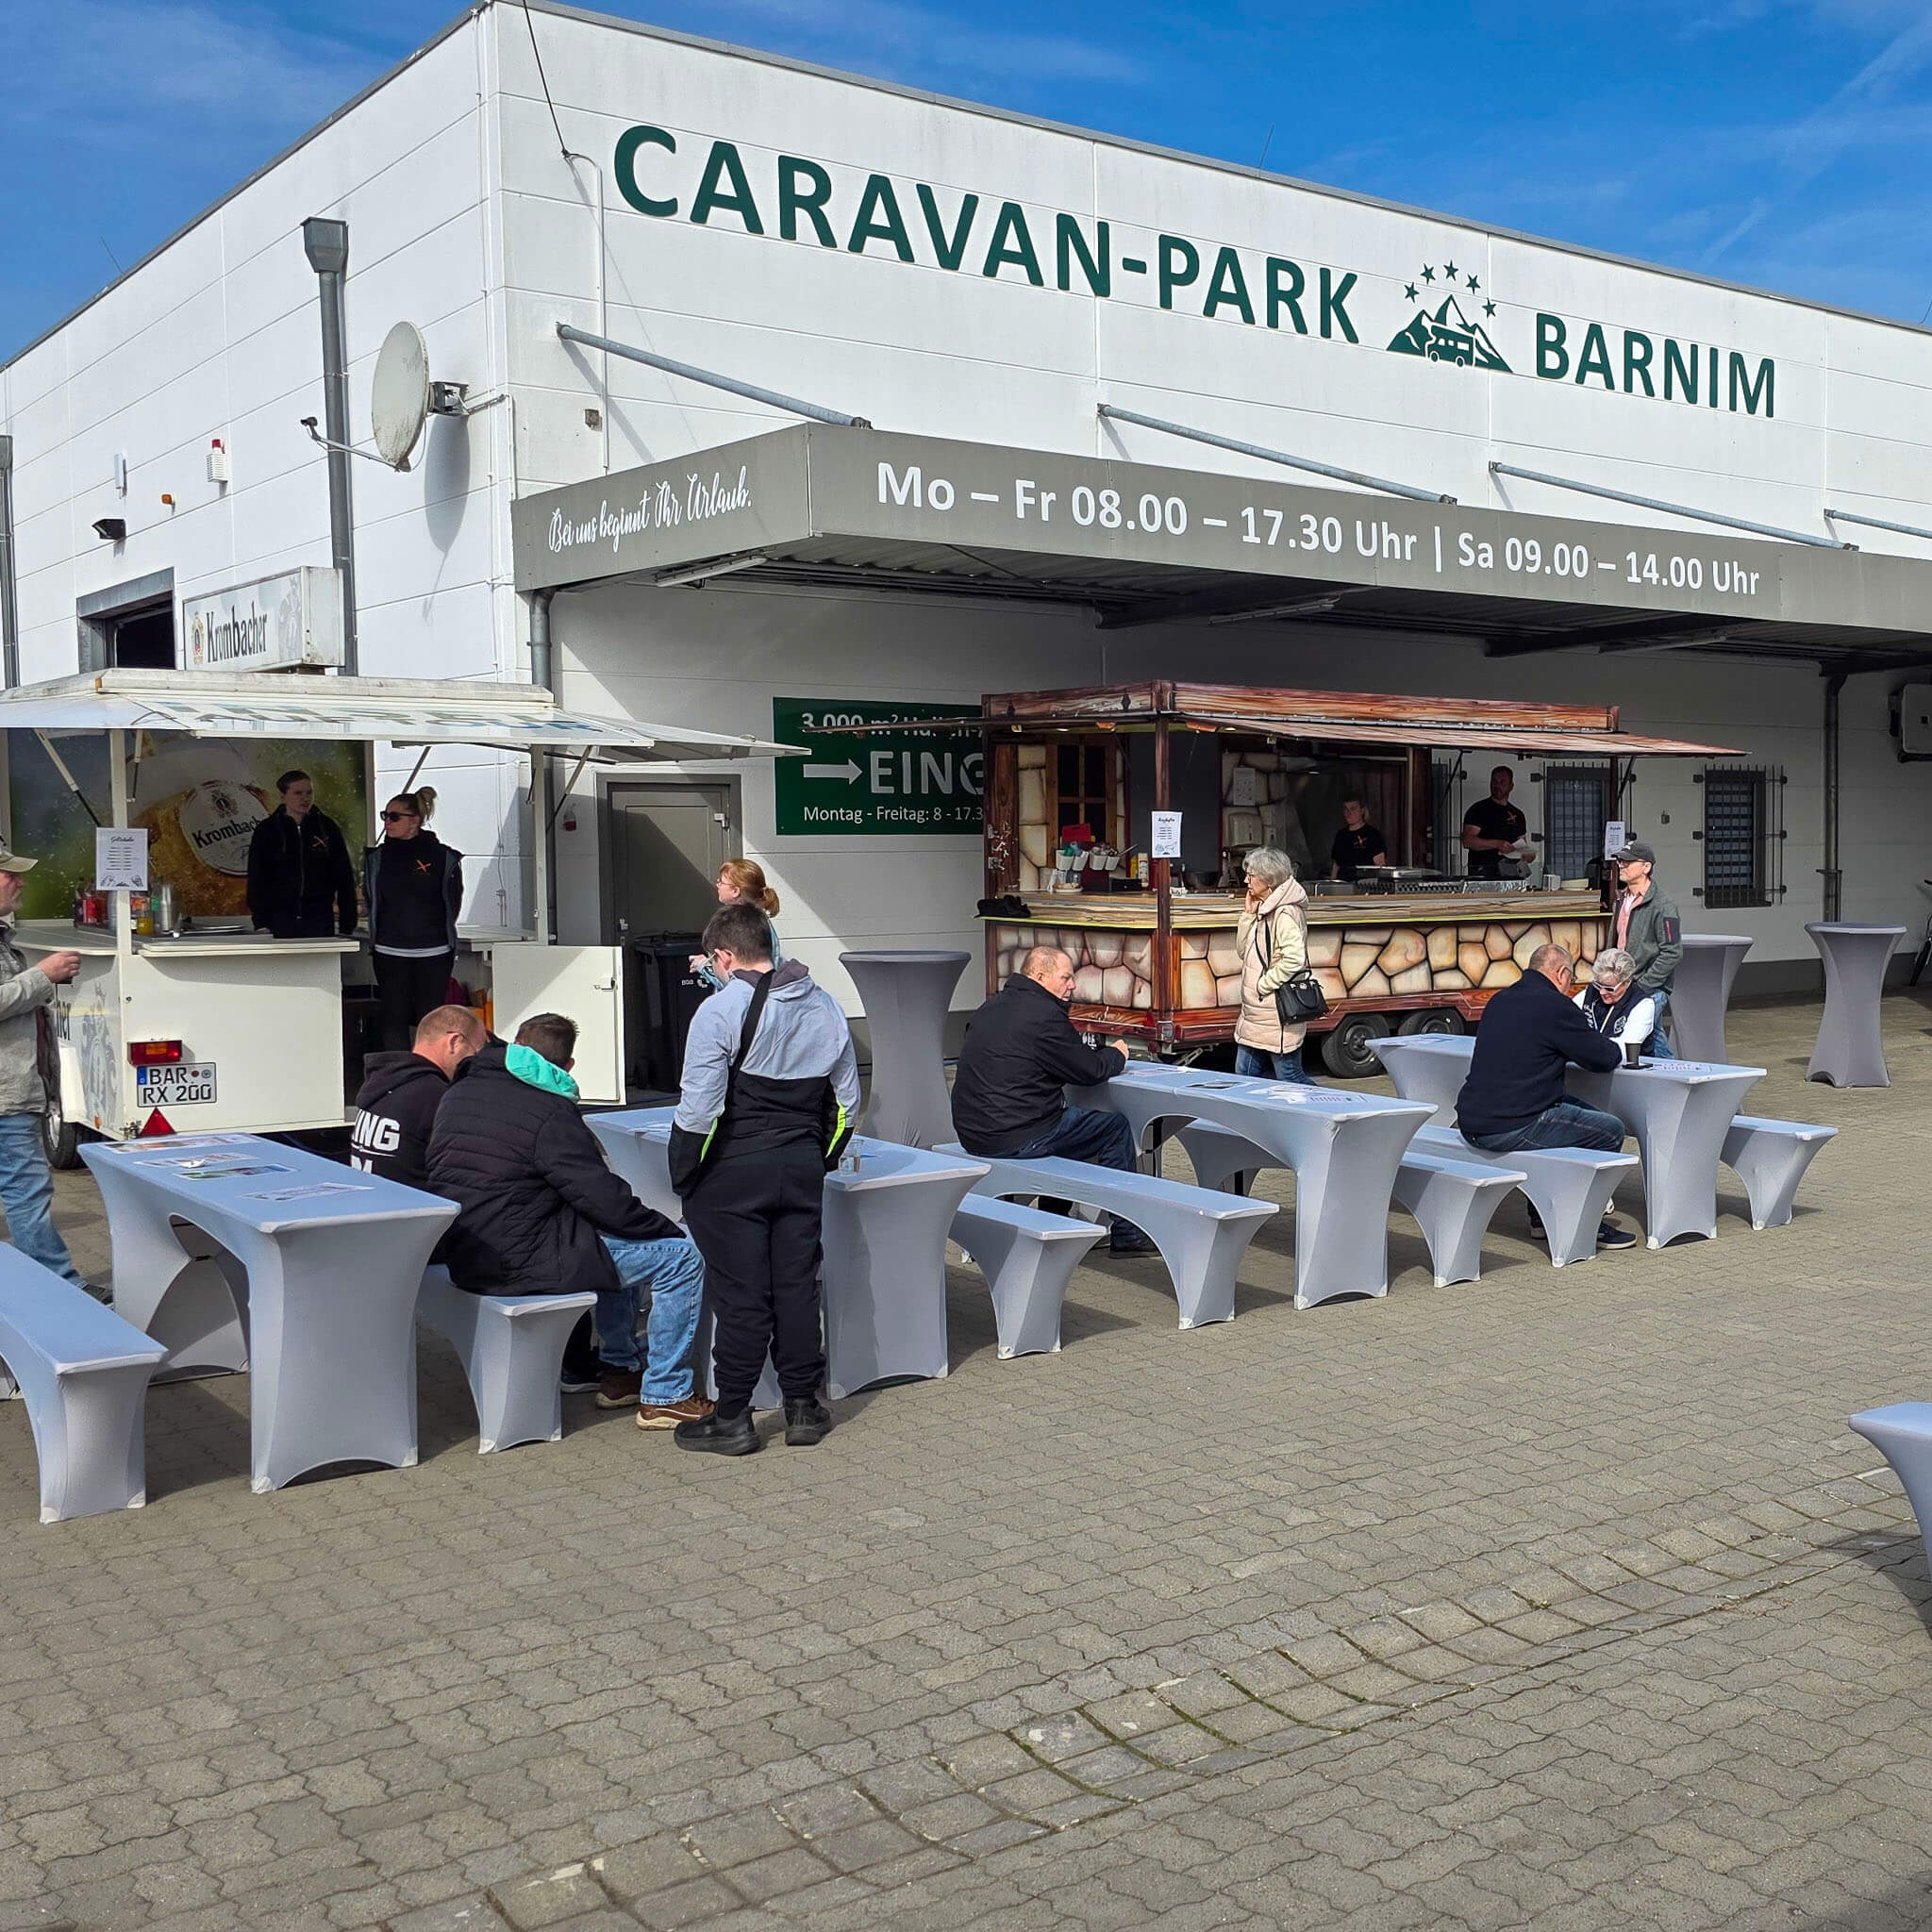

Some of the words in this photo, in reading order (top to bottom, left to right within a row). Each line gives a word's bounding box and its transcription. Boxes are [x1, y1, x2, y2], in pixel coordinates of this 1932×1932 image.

[614, 125, 1358, 344] CARAVAN-PARK
[1536, 312, 1775, 418] BARNIM
[548, 508, 575, 552] Bei
[575, 517, 597, 543] uns
[599, 490, 651, 553] beginnt
[655, 480, 683, 528] Ihr
[687, 465, 752, 522] Urlaub.
[877, 461, 955, 510] Mo
[1015, 478, 1057, 521] Fr
[1072, 486, 1188, 535] 08.00
[1241, 507, 1342, 554] 17.30
[1356, 520, 1417, 560] Uhr
[1458, 533, 1493, 568] Sa
[1505, 538, 1589, 578] 09.00
[1625, 552, 1703, 590] 14.00
[1712, 560, 1759, 595] Uhr
[206, 601, 268, 663] Krombacher
[802, 712, 864, 735] 3000
[804, 807, 862, 824] Montag
[876, 807, 929, 824] Freitag:
[933, 808, 941, 821] 8
[143, 1087, 168, 1104] RX
[176, 1084, 211, 1102] 200
[149, 1067, 188, 1085] BAR
